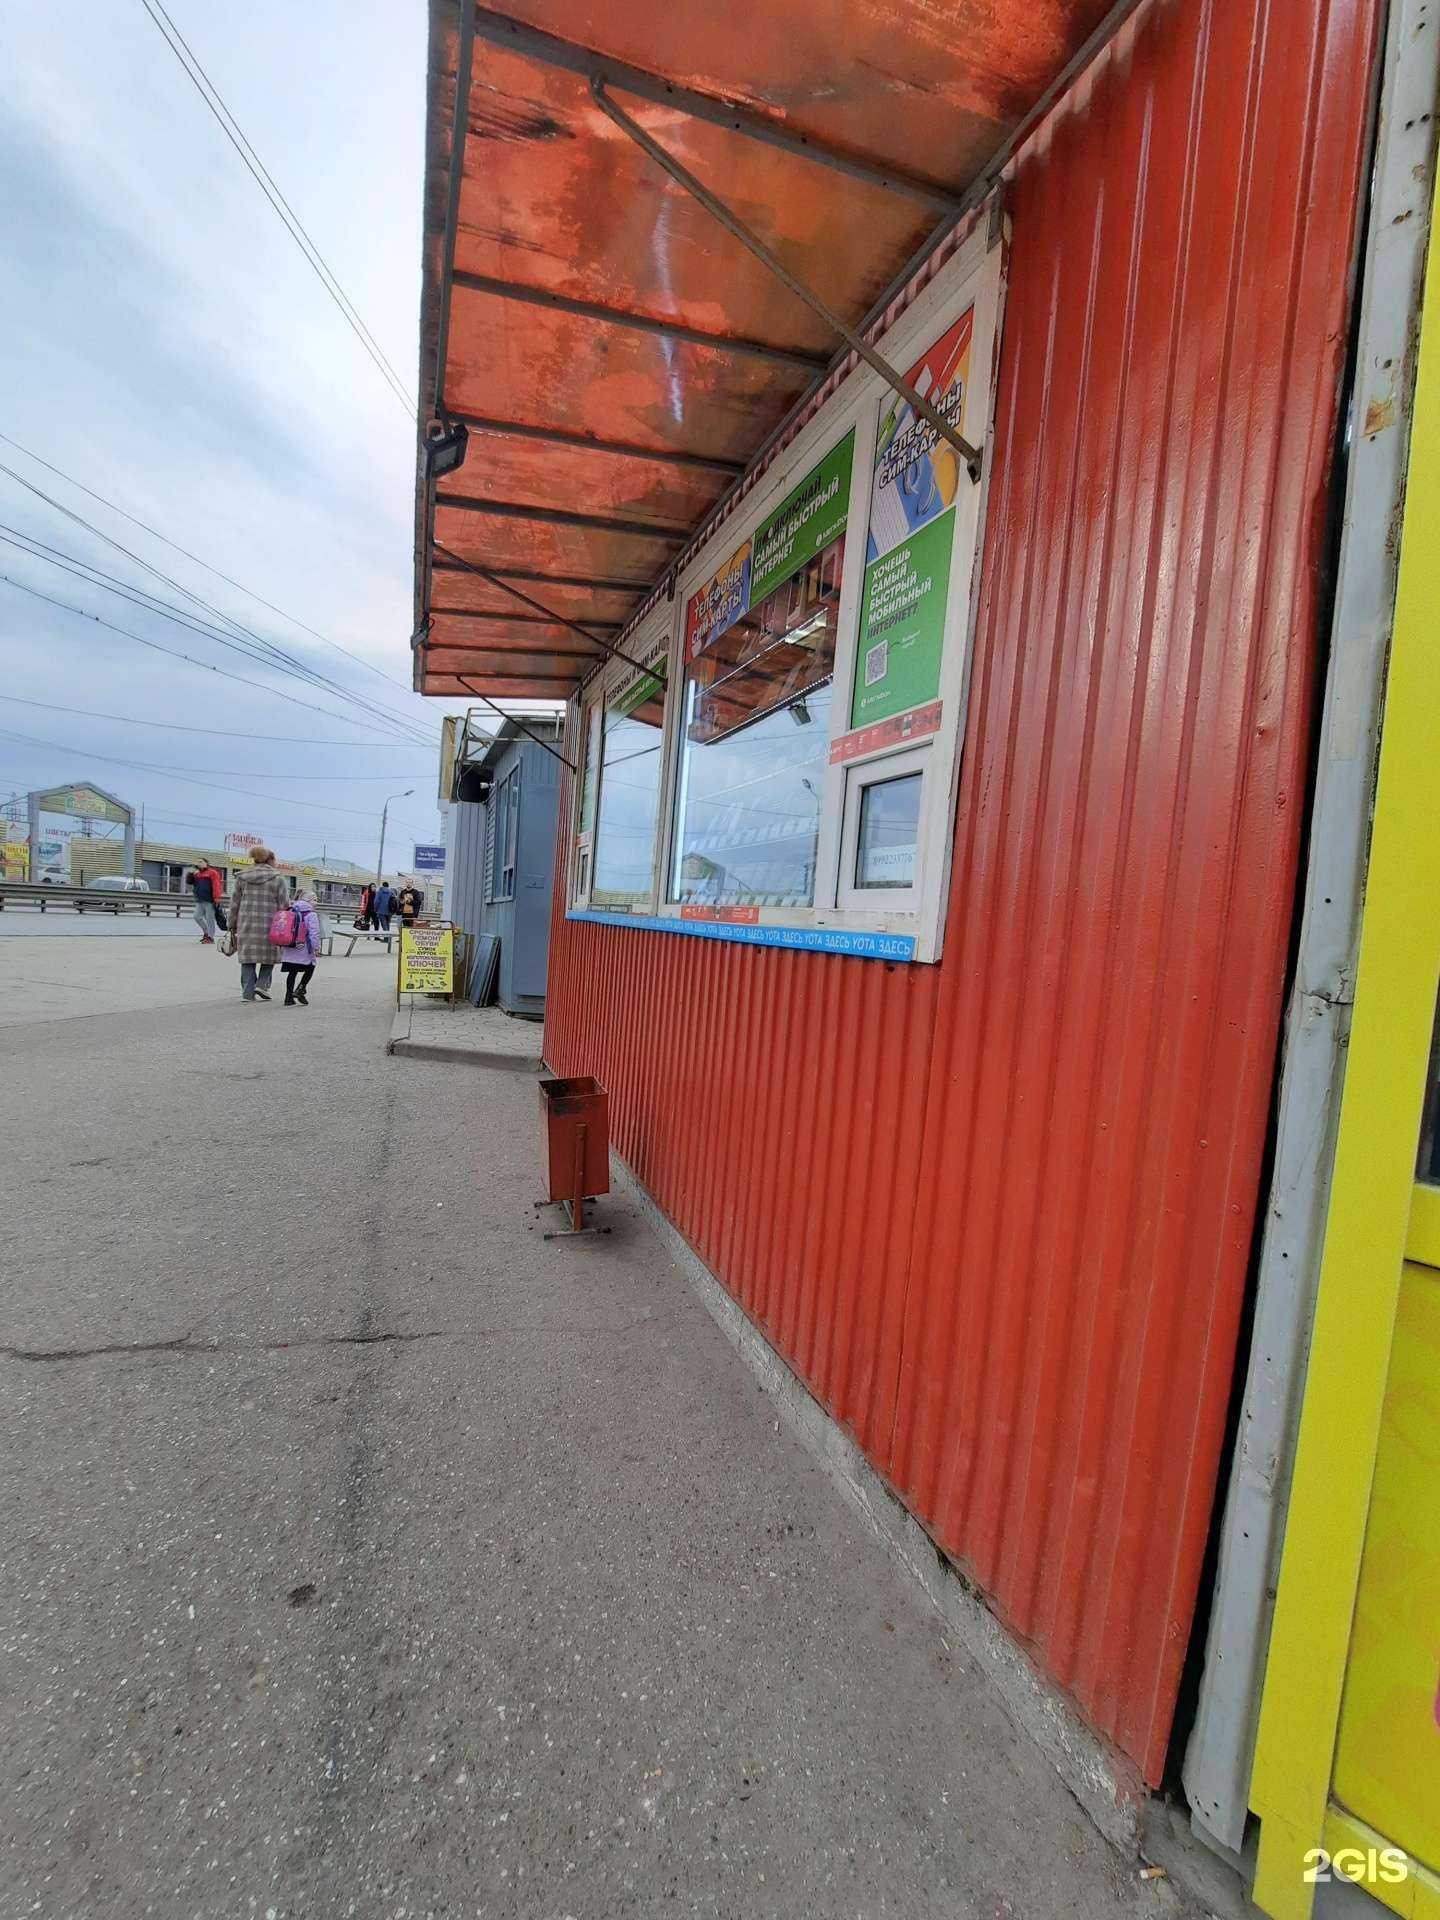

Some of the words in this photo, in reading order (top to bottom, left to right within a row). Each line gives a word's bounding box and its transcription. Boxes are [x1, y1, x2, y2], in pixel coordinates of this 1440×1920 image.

[879, 405, 961, 489] СИМ-КАРЫ
[883, 381, 961, 466] ТЕЛЕФНЫ
[755, 527, 786, 568] САМЫЙ
[788, 474, 840, 539] БЫСТРЫЙ
[753, 539, 795, 586] ИНТЕРНЕТ
[871, 548, 911, 582] ХОЧЕШЬ
[871, 563, 907, 596] САМЫЙ
[694, 562, 743, 622] ТЕЛЕФОНЫ
[868, 576, 932, 626] МОБИЛЬНЫЙ
[869, 570, 917, 611] БЫСТРЫЙ
[691, 587, 743, 647] СИМ-КАРТЫ
[407, 960, 446, 968] КЛЮЧЕЙ
[765, 930, 781, 942] YOTA
[782, 931, 803, 944] ЗДЕСЬ
[805, 933, 822, 945] YOTA
[824, 935, 850, 949] ЗДЕСЬ
[852, 937, 875, 951] YOTA
[879, 939, 911, 955] ЗДЕСЬ
